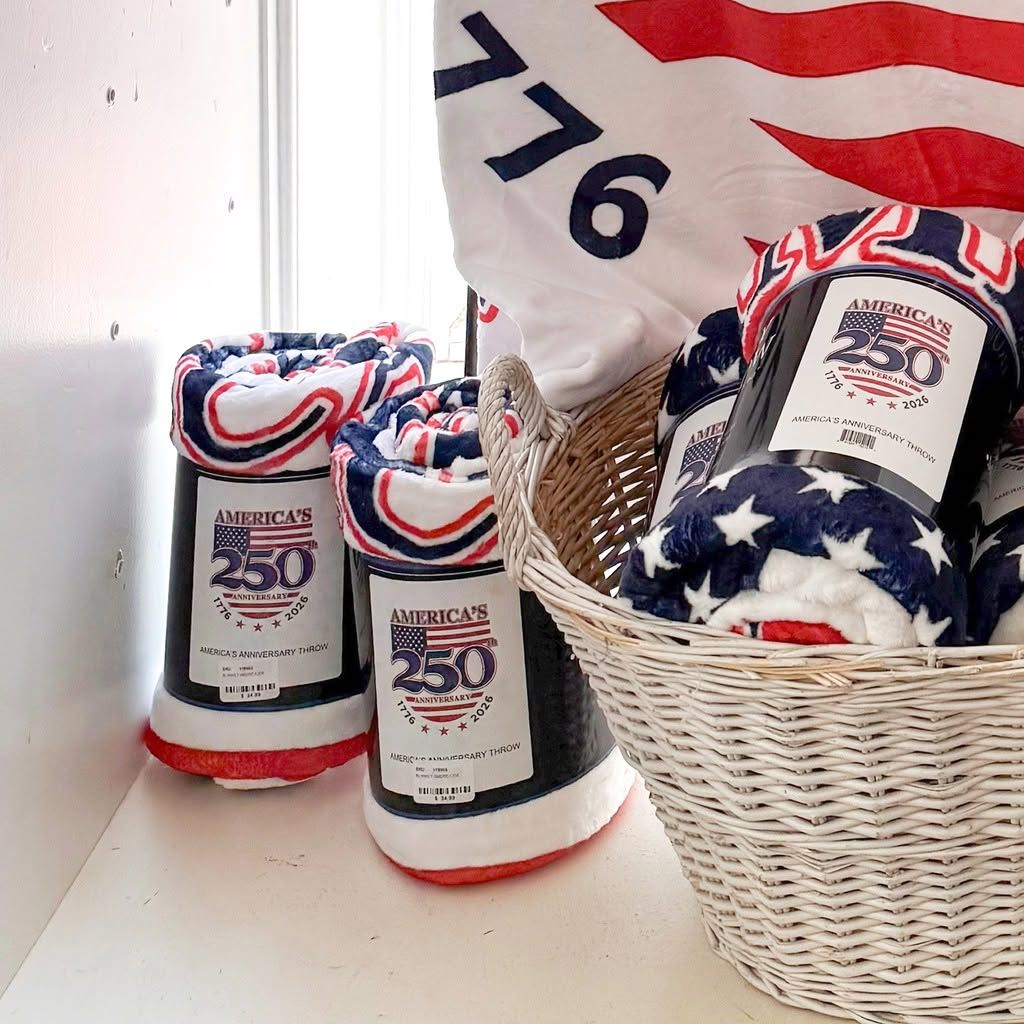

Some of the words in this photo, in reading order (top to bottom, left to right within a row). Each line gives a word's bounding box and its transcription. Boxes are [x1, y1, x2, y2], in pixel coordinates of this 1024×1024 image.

[846, 298, 953, 336] AMERICA'S
[823, 328, 944, 388] 250
[825, 370, 843, 390] 1776
[849, 367, 911, 388] ANNIVERSARY
[902, 395, 928, 410] 2026
[792, 416, 840, 424] AMERICA'S
[841, 418, 905, 444] ANNIVERSARY
[906, 441, 936, 464] THROW
[214, 508, 312, 525] AMERICA'S
[209, 545, 316, 593] 250
[213, 597, 231, 620] 1776
[284, 596, 309, 620] 2026
[390, 603, 488, 625] AMERICA'S
[200, 646, 237, 658] AMERICA'S
[238, 649, 296, 658] ANNIVERSARY
[298, 643, 329, 655] THROW
[391, 644, 497, 695] 250
[415, 694, 471, 704] ANNIVERSARY
[470, 695, 494, 722] 2026
[397, 701, 416, 725] 1776
[489, 742, 521, 756] THROW
